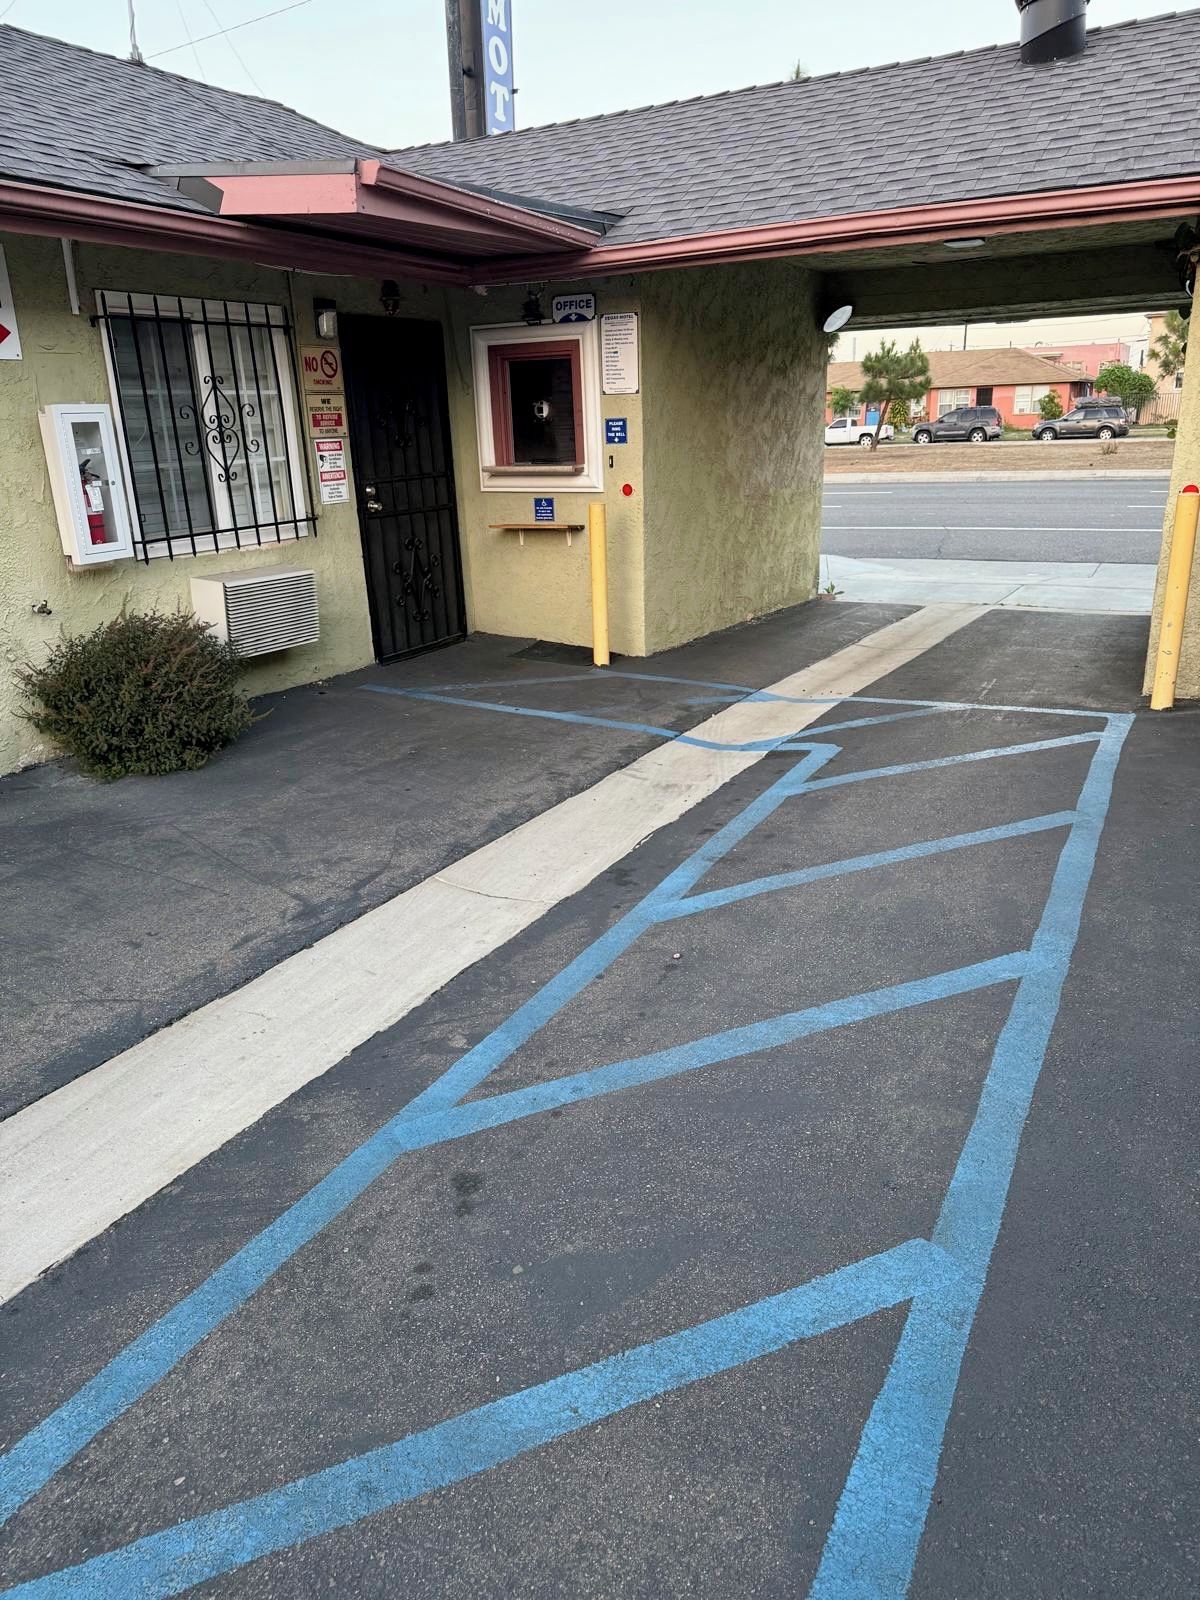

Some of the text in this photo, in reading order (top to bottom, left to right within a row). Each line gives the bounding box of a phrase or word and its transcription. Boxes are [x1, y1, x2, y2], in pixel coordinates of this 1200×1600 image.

[487, 0, 509, 135] MOT
[555, 298, 592, 311] OFFICE
[304, 356, 318, 372] NO
